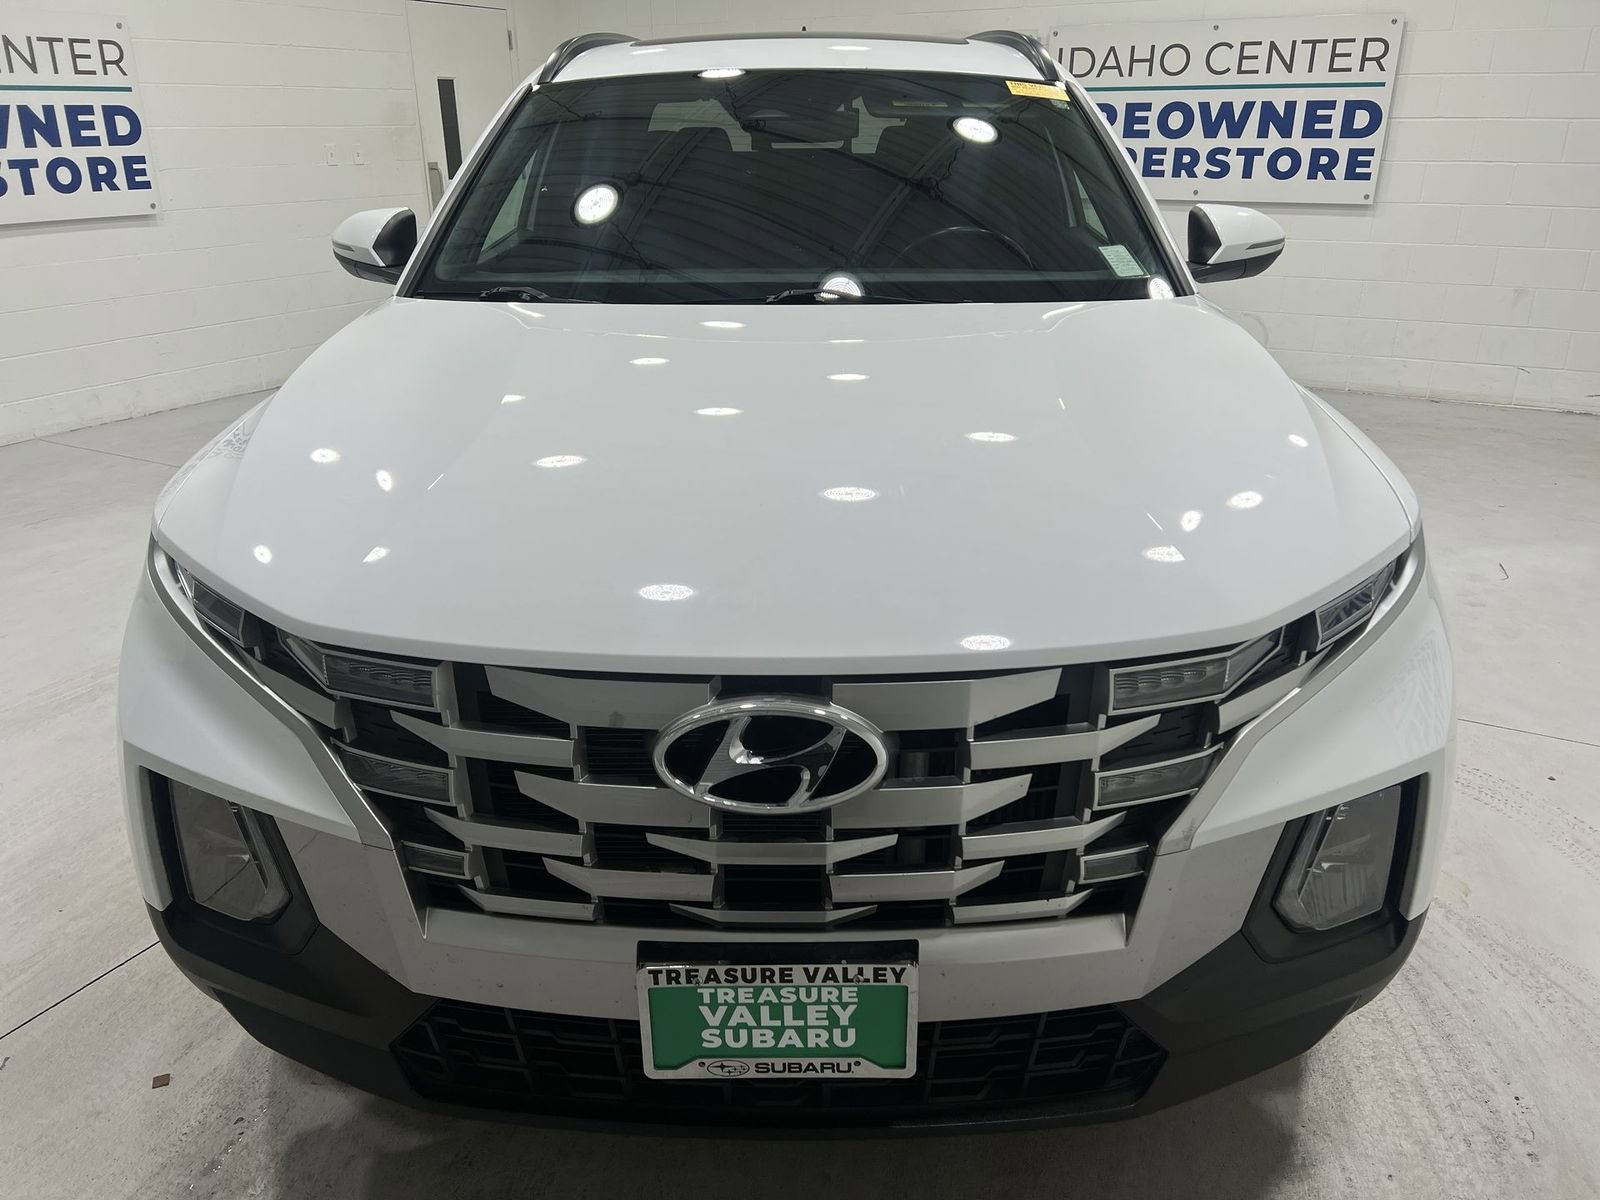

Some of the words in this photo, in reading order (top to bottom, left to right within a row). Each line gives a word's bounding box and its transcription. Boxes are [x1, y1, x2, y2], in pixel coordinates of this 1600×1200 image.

[0, 34, 128, 76] NTER
[1206, 37, 1389, 75] CENTER
[0, 104, 142, 149] NED
[0, 155, 152, 197] TORE
[648, 967, 794, 986] TREASURE
[803, 966, 907, 984] VALLEY
[697, 986, 858, 1004] TREASURE
[698, 1004, 857, 1027] VALLEY
[701, 1028, 857, 1048] SUBARU
[755, 1062, 852, 1074] SUBARU
